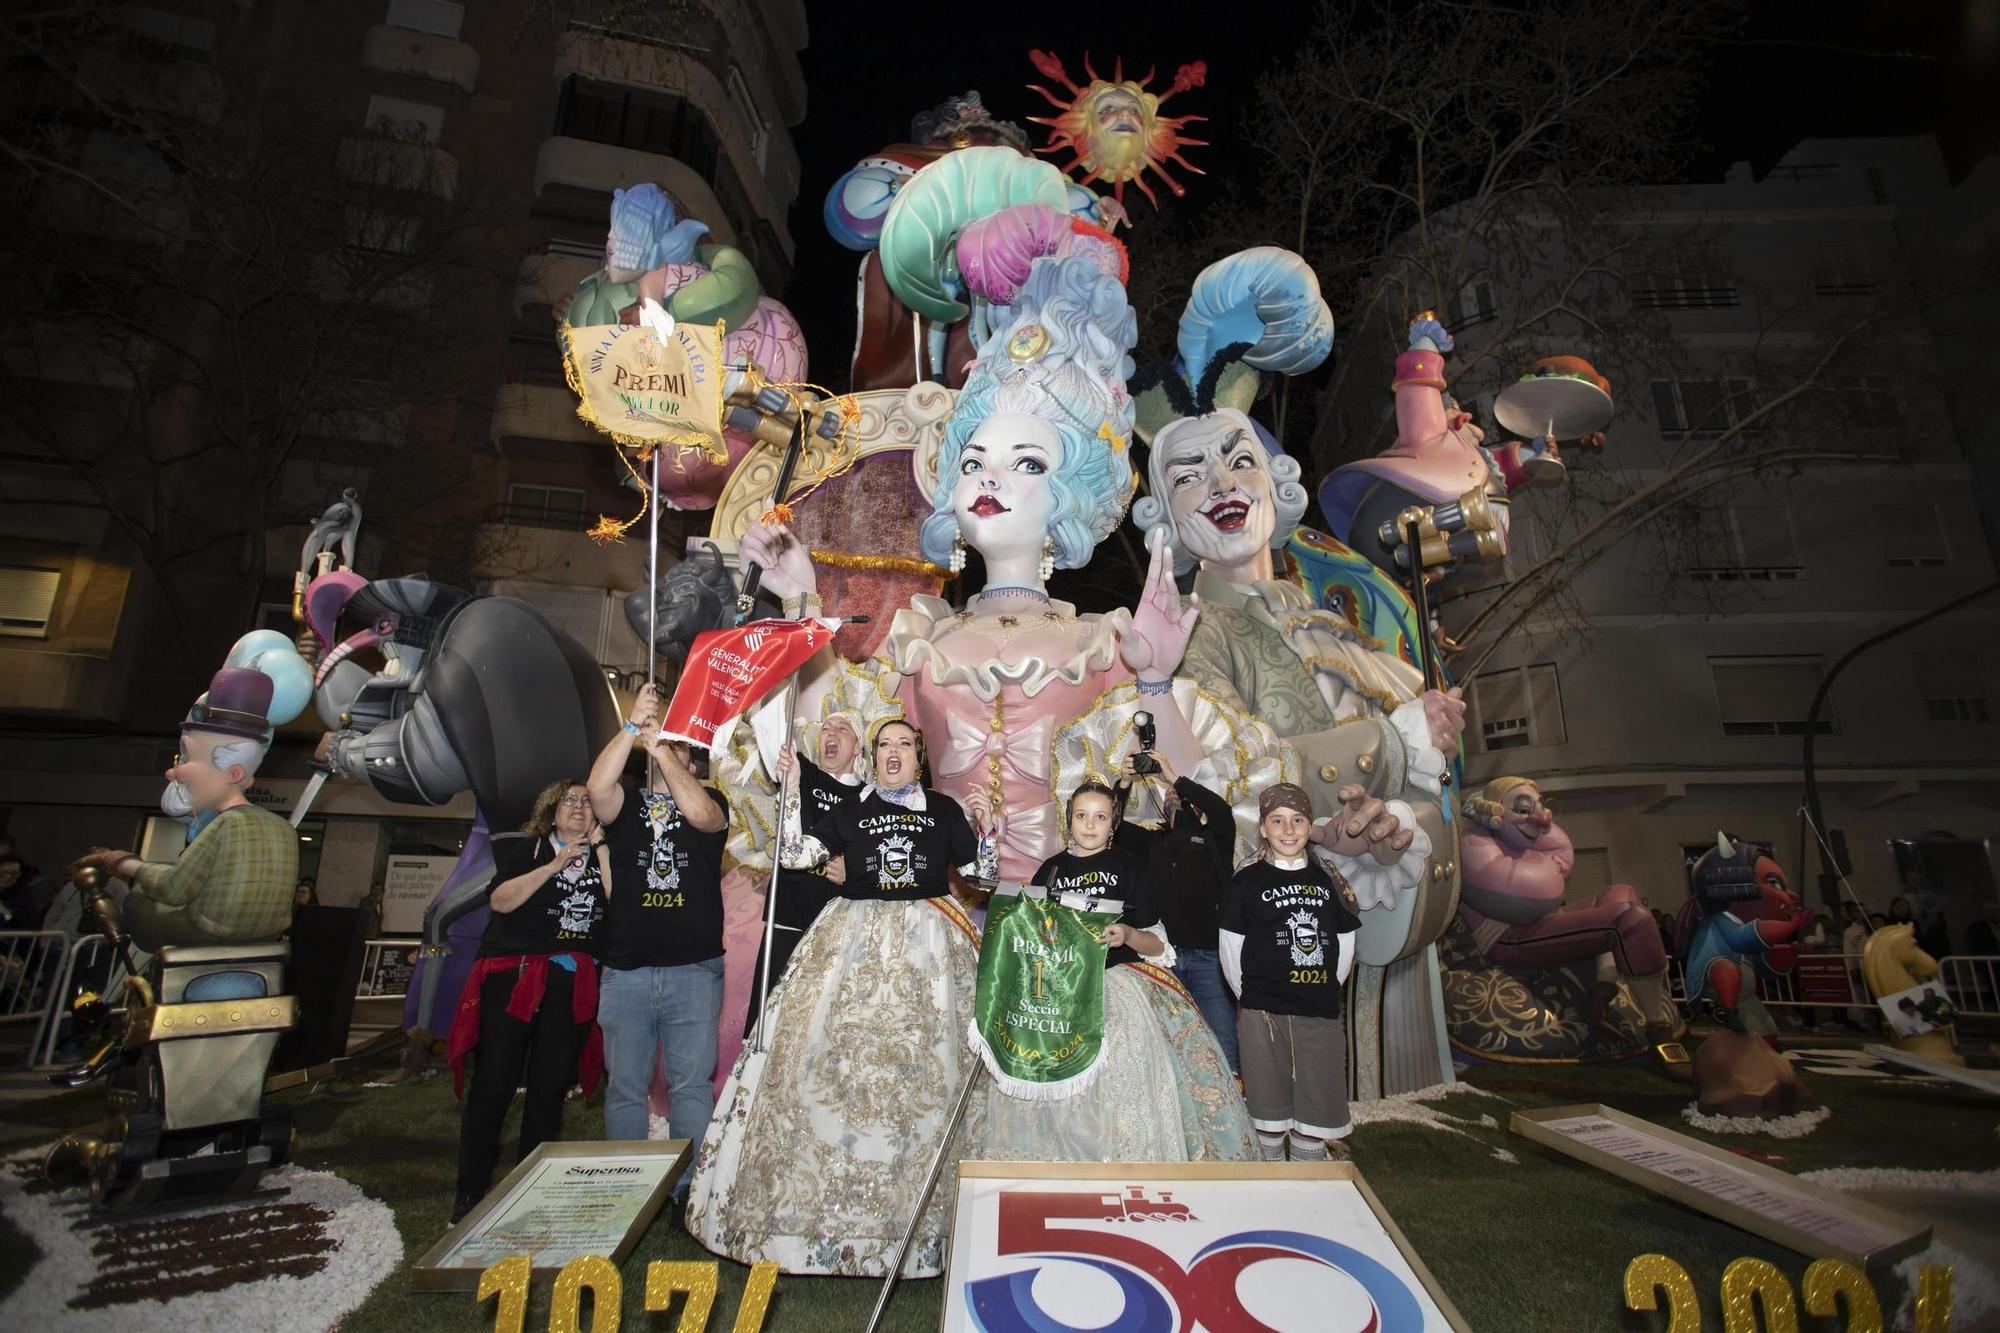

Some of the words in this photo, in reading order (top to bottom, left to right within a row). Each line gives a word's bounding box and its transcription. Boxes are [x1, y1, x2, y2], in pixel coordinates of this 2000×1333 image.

[676, 330, 705, 384] ALLERA
[613, 365, 688, 396] PREMI
[710, 647, 767, 676] GENERALIT
[858, 814, 935, 828] CAMP50NS
[1051, 871, 1119, 891] AMP50NS
[641, 892, 686, 908] 2024
[1012, 935, 1077, 964] PREMI
[1031, 960, 1049, 1000] 1
[1289, 969, 1329, 984] 2024
[1005, 1010, 1073, 1034] ESPECIAL
[1048, 1033, 1084, 1061] 2024
